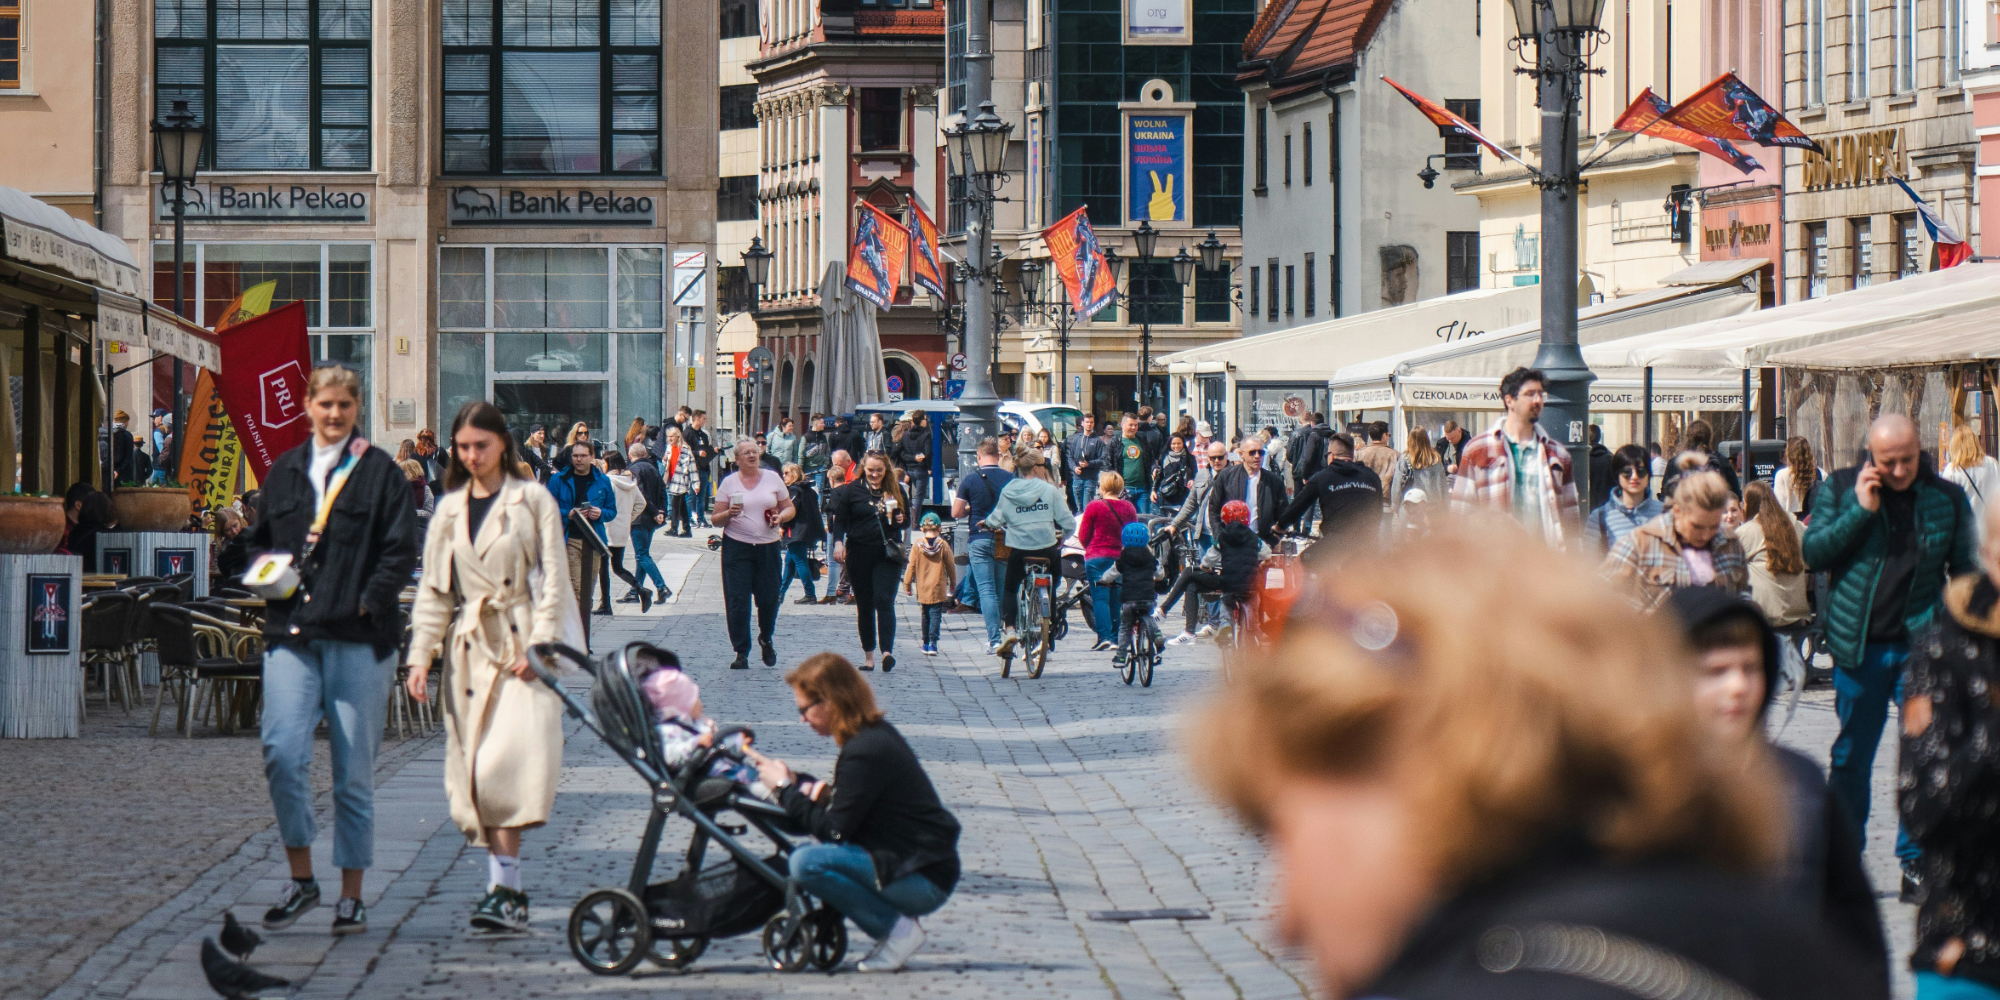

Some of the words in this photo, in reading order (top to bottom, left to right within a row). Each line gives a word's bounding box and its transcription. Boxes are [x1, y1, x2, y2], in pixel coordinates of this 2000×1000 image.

[1147, 8, 1167, 19] org
[1134, 120, 1168, 128] WOLNA
[1134, 131, 1175, 140] UKRAINA
[1779, 136, 1813, 147] BETARD
[219, 185, 282, 209] Bank
[290, 185, 366, 209] Pekao
[509, 190, 571, 213] Bank
[578, 190, 653, 213] Pekao
[270, 376, 296, 417] PRL
[1412, 390, 1468, 400] CZEKOLADA
[244, 413, 261, 448] POLISH
[259, 447, 273, 468] PUB
[1015, 503, 1049, 514] adidas
